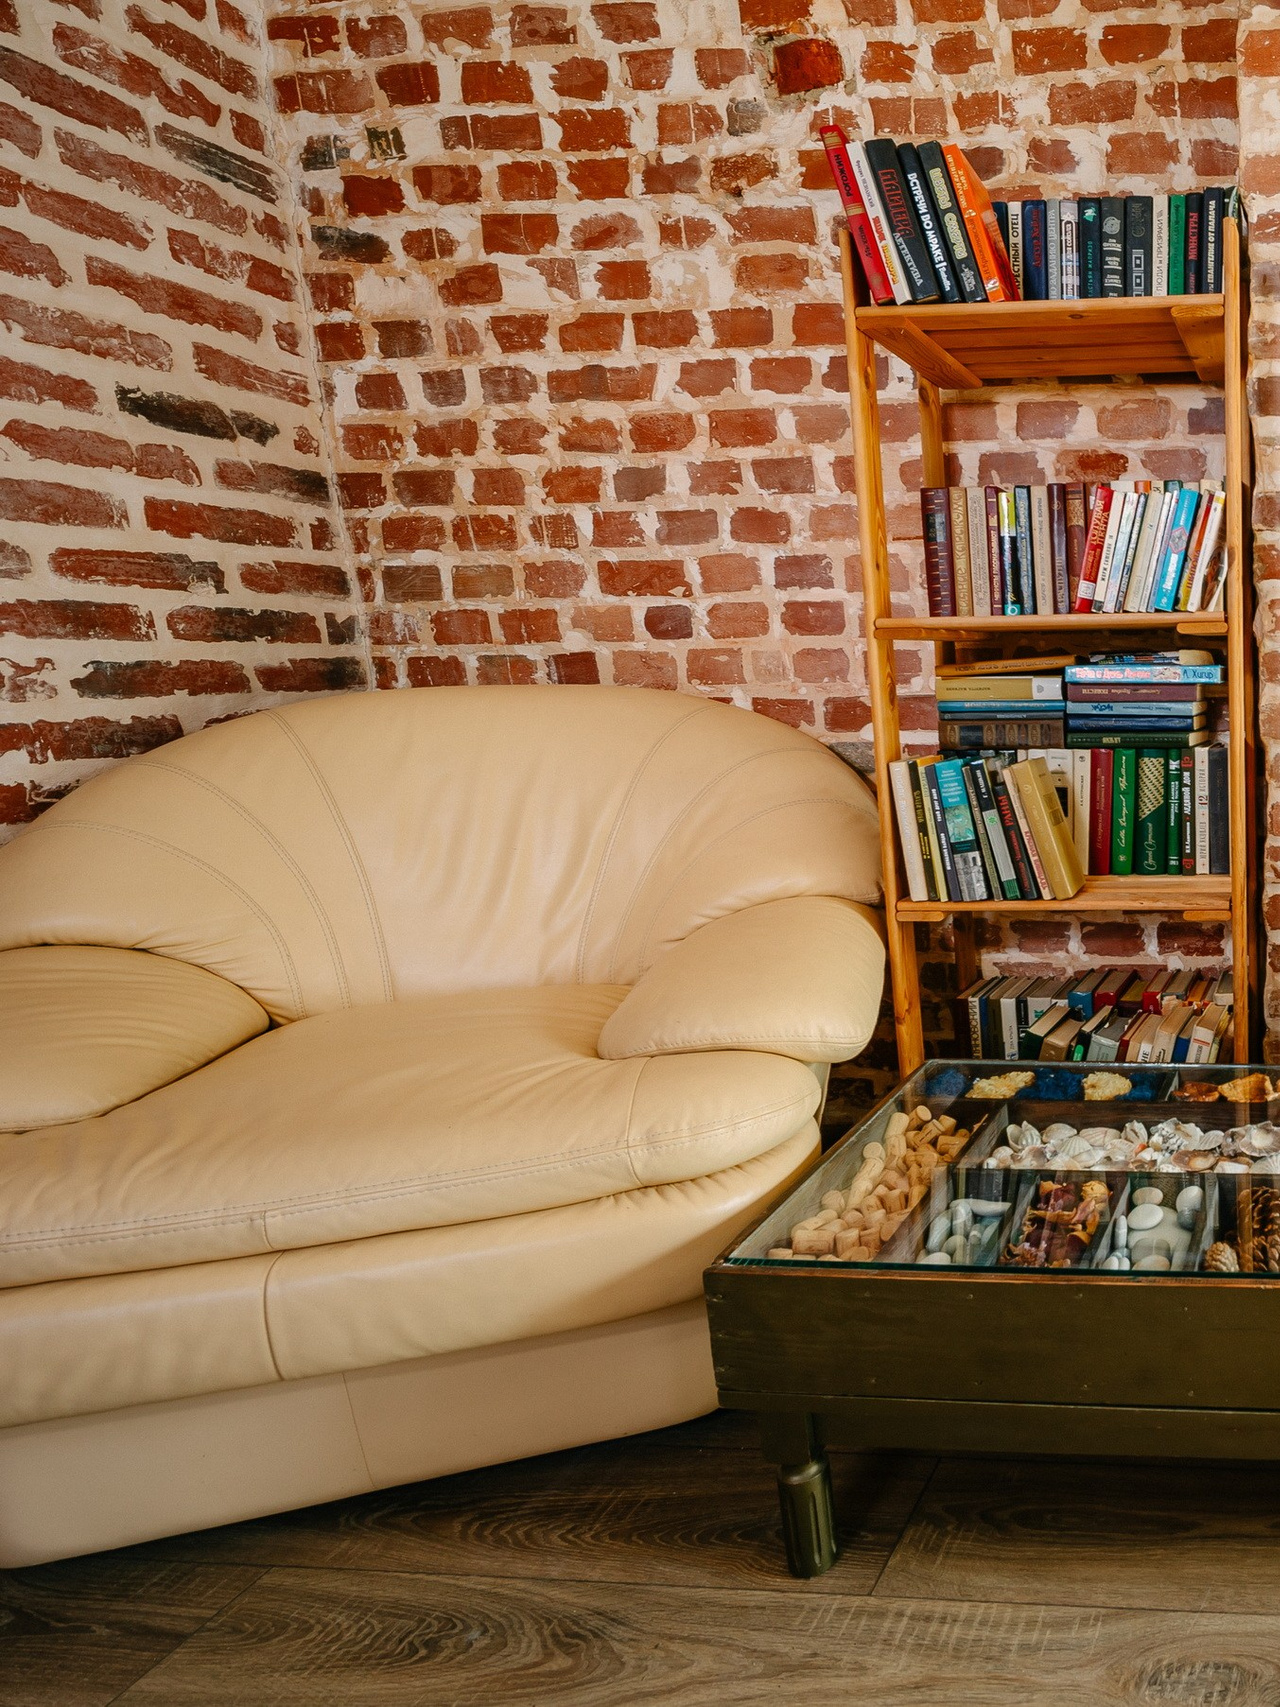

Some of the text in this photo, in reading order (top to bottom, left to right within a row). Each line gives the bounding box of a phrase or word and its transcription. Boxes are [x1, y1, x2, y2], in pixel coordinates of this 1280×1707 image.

[834, 154, 853, 197] РОГОЖИН
[907, 172, 944, 264] ВСТРЕЧИ ВО МРАКЕ
[929, 167, 952, 210] ЦВЕТЫ
[943, 212, 968, 260] СМЕРТИ
[1048, 209, 1057, 240] ЦЕНТРА
[1208, 200, 1216, 231] ПАЛАЧА
[1010, 213, 1020, 290] КРЕСТНЫЙ ОТЕЦ
[1188, 212, 1198, 260] МОНСТРЫ
[1208, 231, 1215, 242] ОТ
[893, 232, 924, 287] ДЕТЕКТИВА
[1048, 243, 1057, 285] ЗАДАНИЮ
[1207, 242, 1215, 283] ЕВАНГЕЛИЕ
[1090, 500, 1105, 545] ГОЛУБАЯ
[1182, 771, 1191, 786] ДОМ
[1198, 768, 1206, 792] ИСТОРИЙ
[998, 795, 1015, 827] РАНЫ
[1182, 786, 1191, 815] ЛЕДЯНОЙ
[1198, 795, 1208, 806] 12
